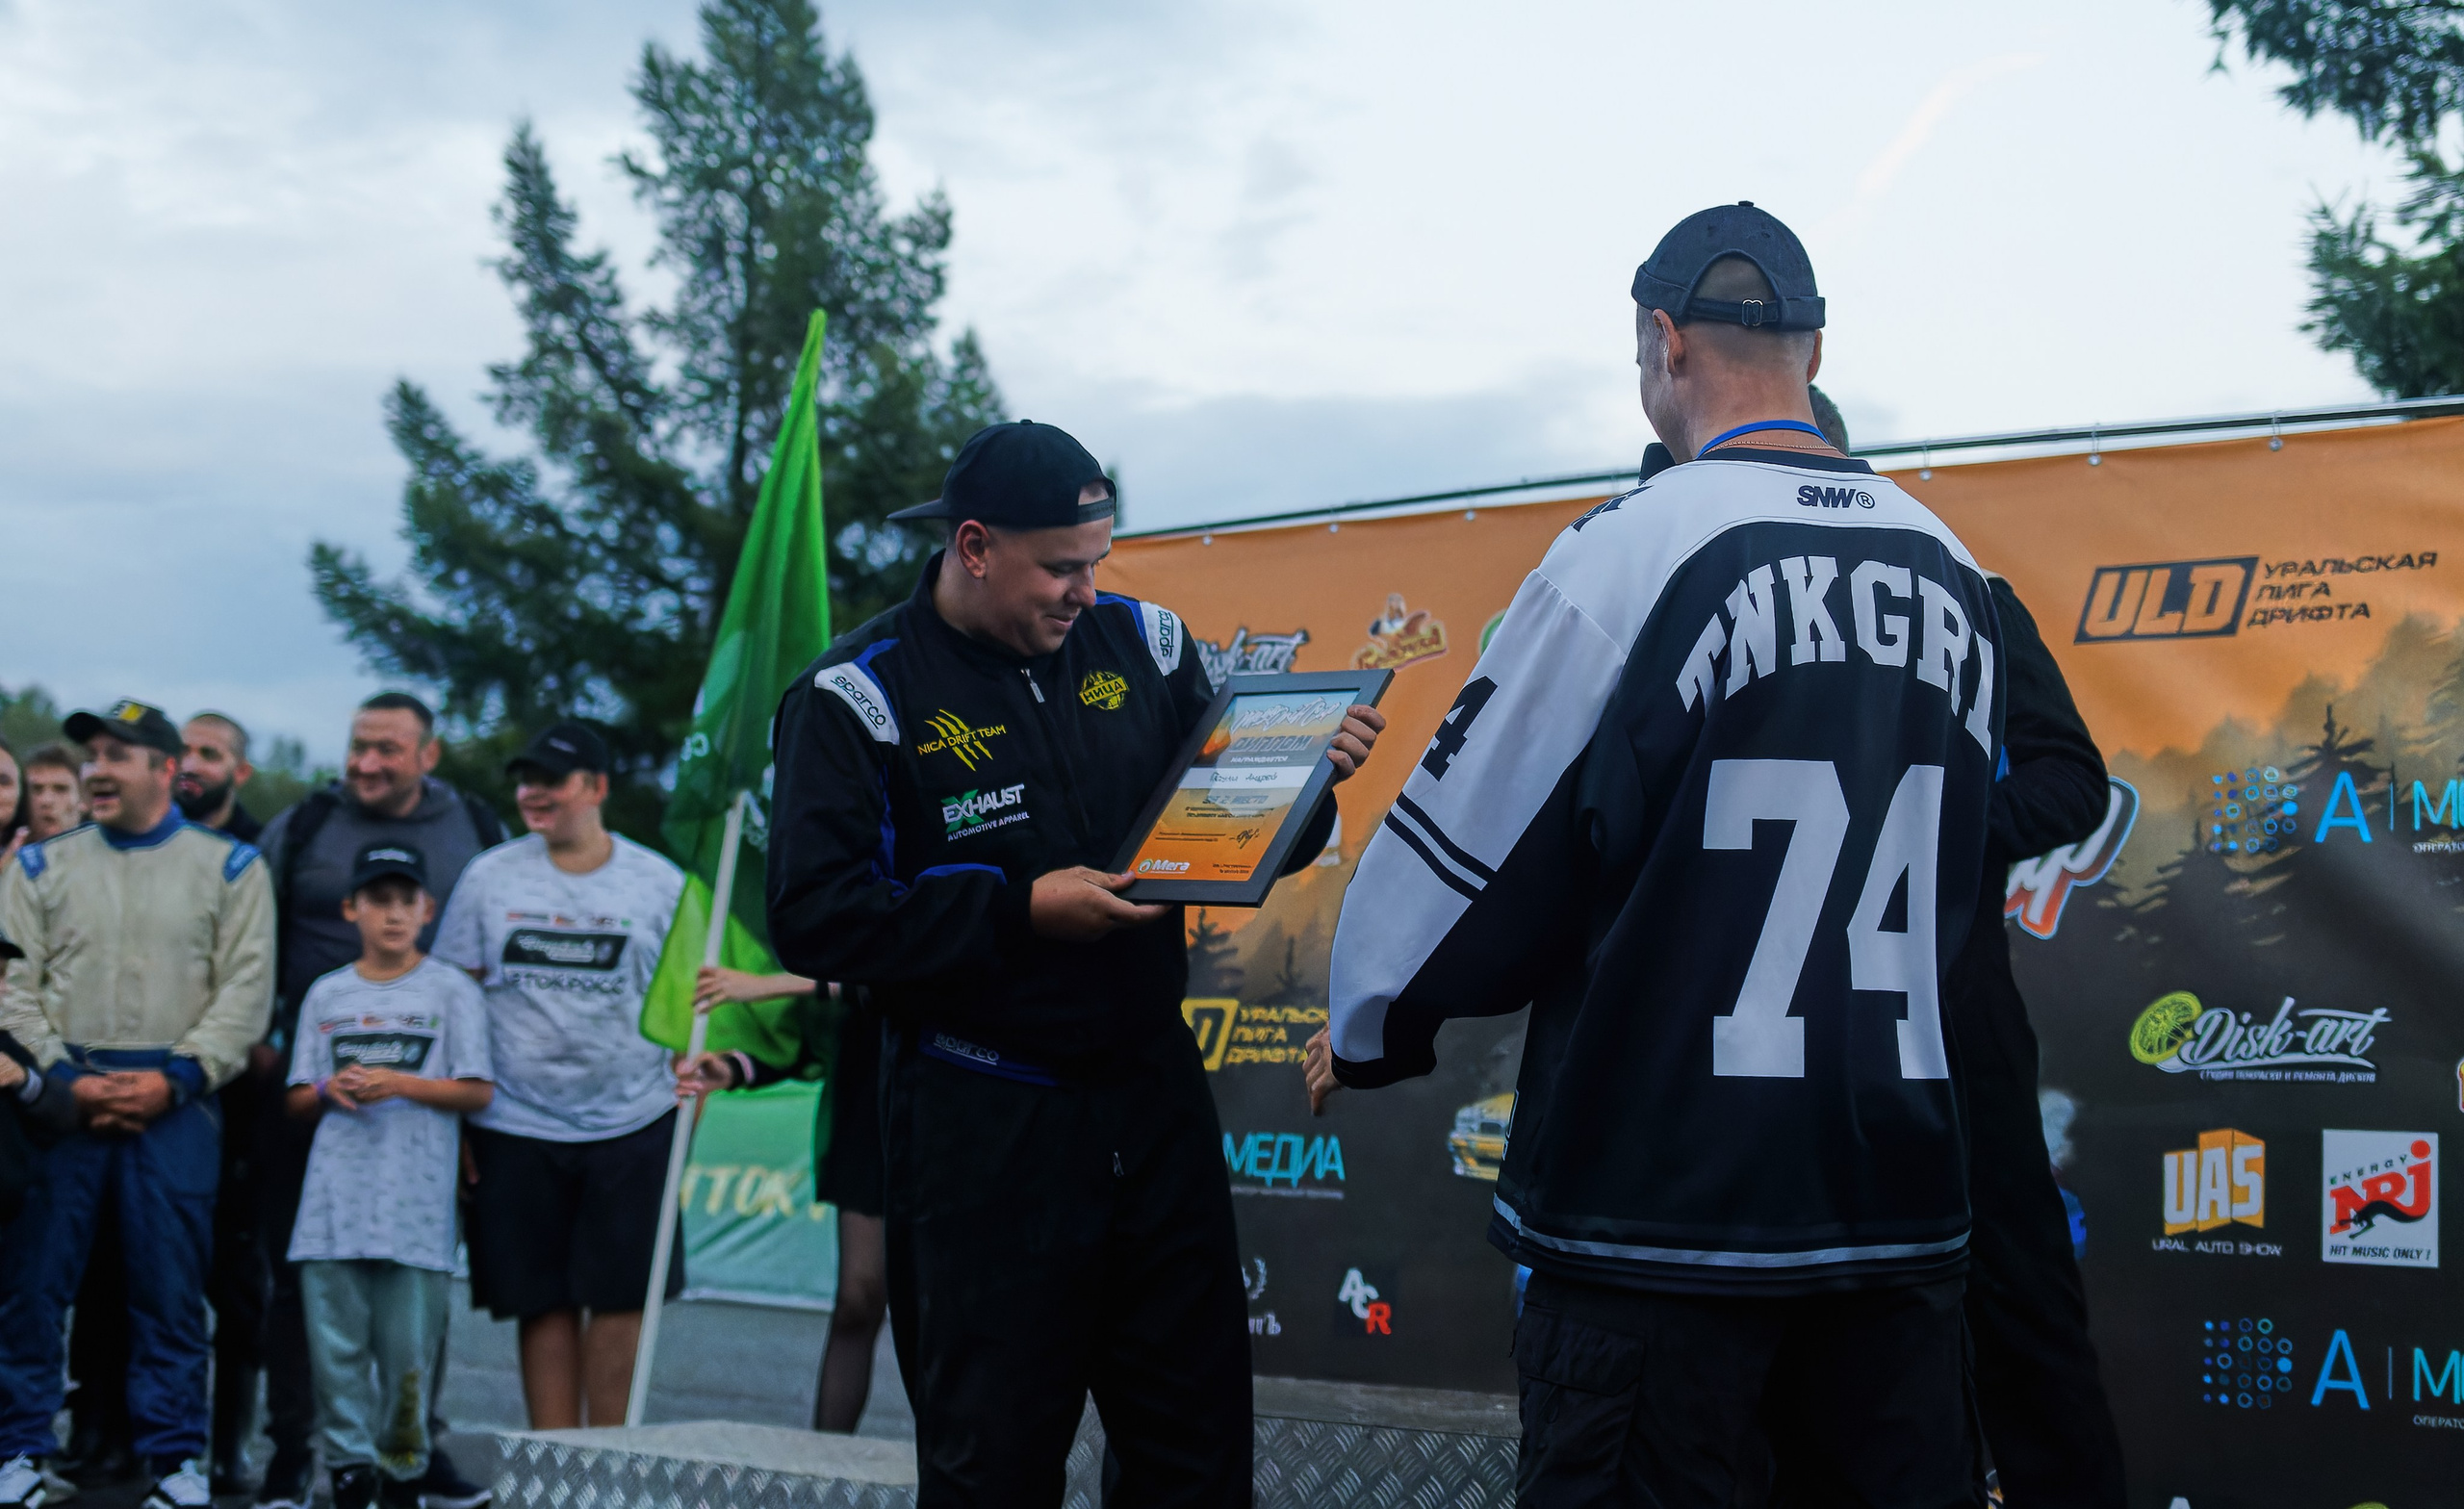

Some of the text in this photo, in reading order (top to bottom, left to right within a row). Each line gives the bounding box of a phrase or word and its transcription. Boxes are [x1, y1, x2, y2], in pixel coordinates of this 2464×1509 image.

[2265, 551, 2438, 579] УРАЛЬСКАЯ
[2085, 564, 2246, 637] ULD
[2247, 602, 2371, 628] ДРИФТА
[831, 676, 886, 729] sparco
[1083, 680, 1124, 703] НИЦА
[917, 725, 1007, 755] NICA DRIFT TEAM
[942, 783, 1025, 825] EXHAUST
[947, 811, 1030, 842] AUTOMOTIVE APPAREL
[1703, 759, 1949, 1079] 74
[2190, 996, 2393, 1064] Disk-art
[1222, 1132, 1346, 1189] МЕДИА
[2330, 1155, 2407, 1185] ENERGY
[2164, 1143, 2264, 1224] UAS
[2152, 1239, 2282, 1257] URAL AUTO SHOW
[2330, 1245, 2348, 1256] HIT
[2351, 1246, 2389, 1259] MUSIC
[2393, 1248, 2423, 1260] ONLY
